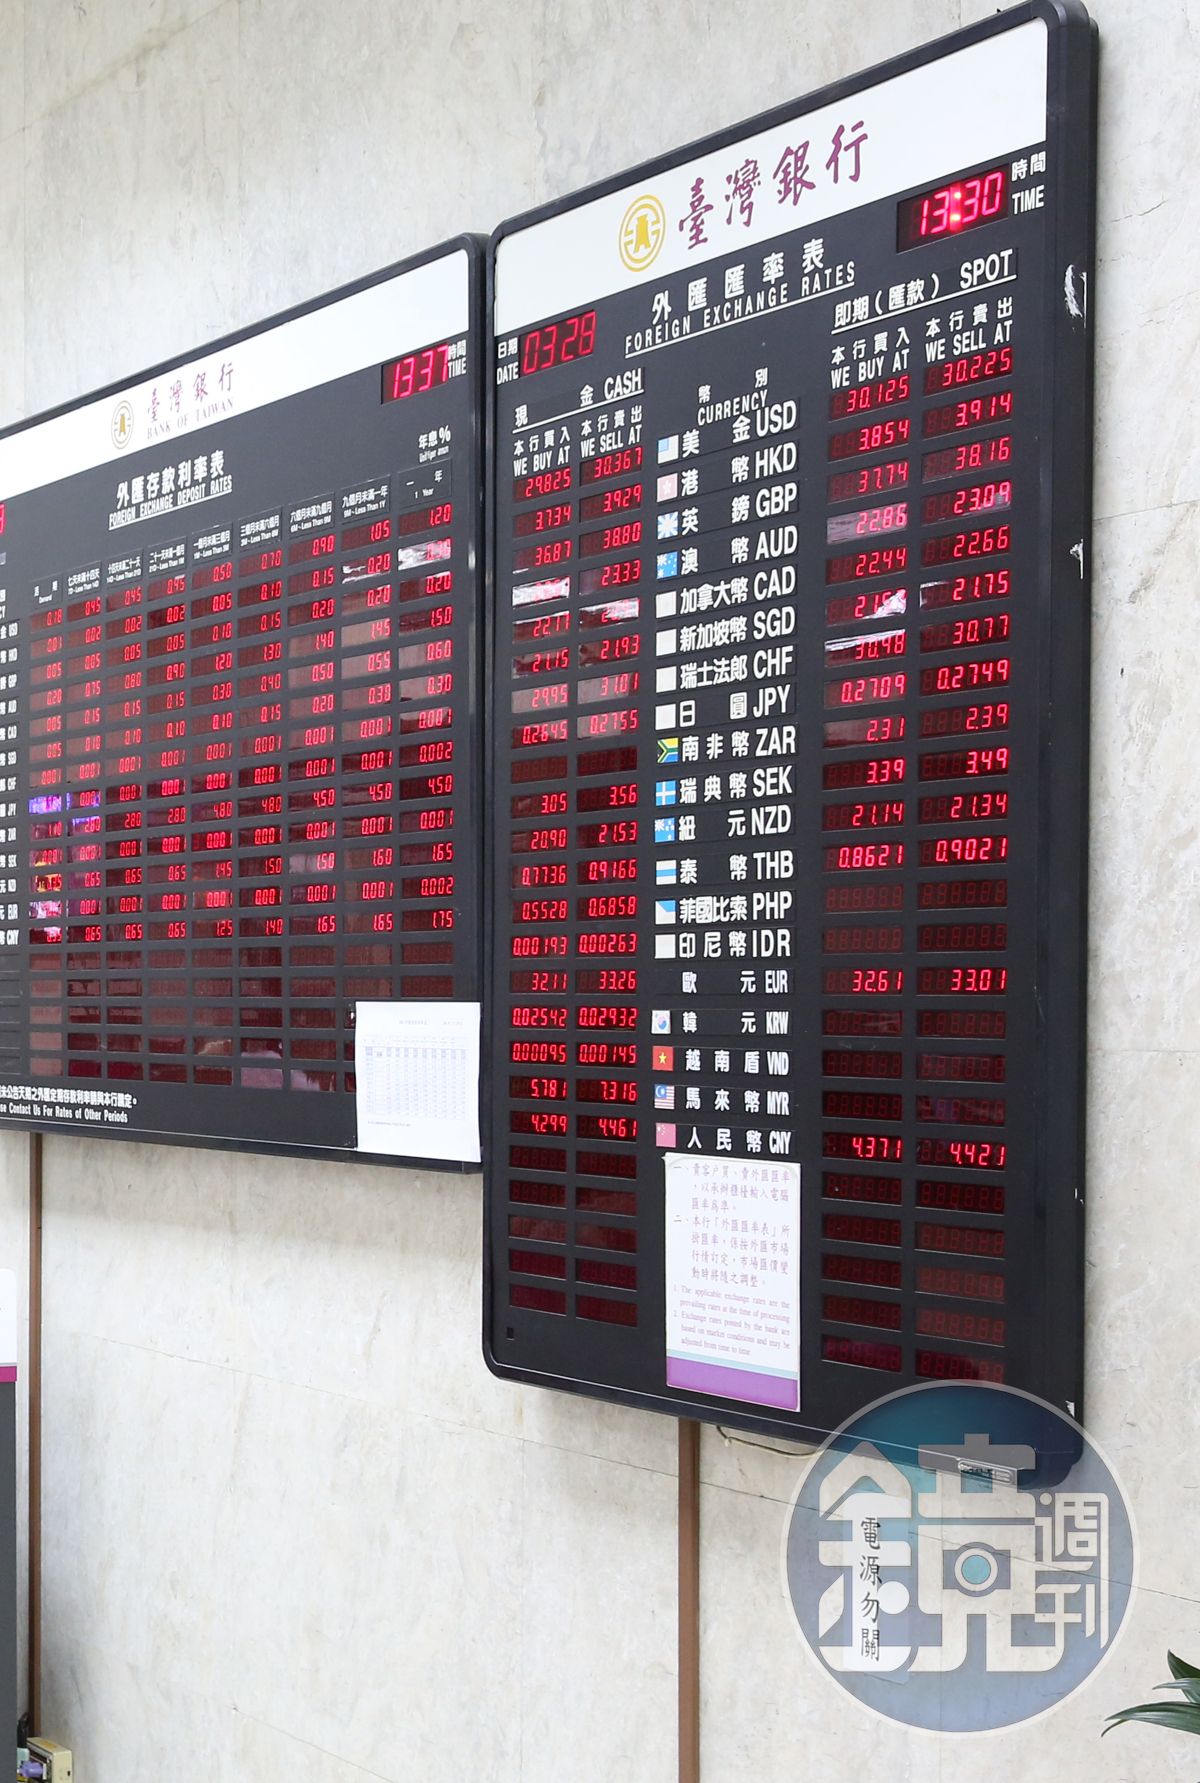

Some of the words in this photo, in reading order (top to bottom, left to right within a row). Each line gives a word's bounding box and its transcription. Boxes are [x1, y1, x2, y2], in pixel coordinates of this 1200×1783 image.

[1012, 151, 1046, 181] 時間
[679, 120, 868, 249] 臺灣銀行
[1012, 185, 1044, 214] TIME
[921, 172, 1002, 234] 13:30
[652, 238, 824, 324] 外匯匯率表
[960, 250, 1013, 288] SPOT
[625, 314, 691, 353] FOREIGN
[703, 283, 788, 327] EXCHANGE
[802, 261, 855, 296] RATES
[926, 297, 1012, 337] 本行賣出
[448, 340, 466, 359] 時間
[498, 337, 517, 358] 日期
[832, 327, 909, 365] 本行買入
[926, 338, 945, 362] WE
[953, 328, 986, 355] SELL
[994, 320, 1012, 344] AT
[448, 358, 466, 378] TIME
[497, 362, 518, 384] DATE
[831, 366, 850, 389] WE
[859, 356, 884, 382] BUY
[893, 349, 909, 372] AT
[943, 348, 1010, 385] 30.225
[148, 363, 234, 421] 臺灣銀行
[604, 368, 643, 399] CASH
[847, 376, 908, 411] 30.125
[147, 422, 171, 440] BANK
[177, 413, 189, 429] OF
[196, 397, 234, 421] TAIWAN
[581, 405, 642, 436] 本行賣出
[698, 389, 767, 425] CURRENCY
[757, 401, 796, 436] USD
[956, 394, 1010, 426] 3.914
[514, 428, 570, 456] 本行買入
[581, 438, 595, 458] WE
[600, 430, 623, 453] SELL
[628, 424, 642, 445] AT
[859, 420, 908, 450] 3.854
[514, 457, 527, 476] WE
[534, 451, 552, 472] BUY
[558, 445, 570, 465] AT
[755, 442, 796, 478] HKD
[956, 438, 1009, 469] 38.16
[117, 450, 224, 508] 外匯存款利率表
[859, 463, 907, 492] 37.74
[109, 507, 136, 527] FOREIGN
[140, 494, 173, 516] EXCHANGE
[177, 483, 206, 504] DEPOSIT
[210, 475, 232, 495] RATES
[756, 483, 797, 517] GBP
[954, 482, 1010, 513] 23.09
[856, 504, 906, 533] 22.86
[755, 526, 797, 560] AUD
[954, 526, 1008, 556] 22.66
[856, 548, 905, 575] 22.44
[680, 577, 748, 614] 加拿大幣
[754, 566, 795, 600] CAD
[953, 571, 1008, 600] 21.75
[680, 616, 747, 652] 新加坡幣
[753, 606, 795, 639] SGD
[954, 615, 1008, 644] 30.77
[856, 632, 904, 659] 30.48
[680, 655, 747, 689] 瑞士法郎
[754, 646, 793, 678] CHF
[938, 660, 1008, 689] 0.2749
[753, 685, 790, 717] JPY
[842, 675, 905, 702] 0.2709
[867, 719, 904, 741] 2.31
[967, 704, 1007, 729] 2.39
[682, 731, 749, 762] 南非幣
[756, 726, 795, 756] ZAR
[867, 760, 904, 783] 3.39
[967, 748, 1007, 773] 3.49
[680, 772, 747, 803] 瑞典幣
[753, 766, 792, 797] SEK
[752, 805, 791, 835] NZD
[853, 804, 902, 825] 21.14
[951, 795, 1006, 817] 21.34
[753, 850, 793, 879] THB
[839, 845, 902, 868] 0.8621
[936, 838, 1006, 862] 0.9021
[680, 895, 747, 923] 菲國比索
[753, 891, 792, 920] PHP
[679, 931, 746, 958] 印尼幣
[753, 929, 790, 957] IDR
[766, 970, 788, 993] EUR
[853, 971, 901, 991] 32.61
[952, 970, 1005, 991] 33.01
[766, 1012, 788, 1034] KRW
[686, 1049, 759, 1073] 越南盾
[767, 1051, 788, 1075] VND
[9, 1102, 31, 1115] Contact
[33, 1104, 40, 1115] Us
[43, 1105, 53, 1116] For
[55, 1106, 72, 1118] Rates
[75, 1108, 81, 1119] of
[85, 1108, 101, 1120] Other
[104, 1110, 127, 1122] Periods
[686, 1087, 760, 1112] 馬來幣
[767, 1091, 789, 1115] MYR
[688, 1127, 761, 1152] 人民幣
[769, 1131, 791, 1154] CNY
[853, 1138, 900, 1157] 4.371
[951, 1144, 1004, 1165] 4.421
[860, 1517, 882, 1662] 電源勿關
